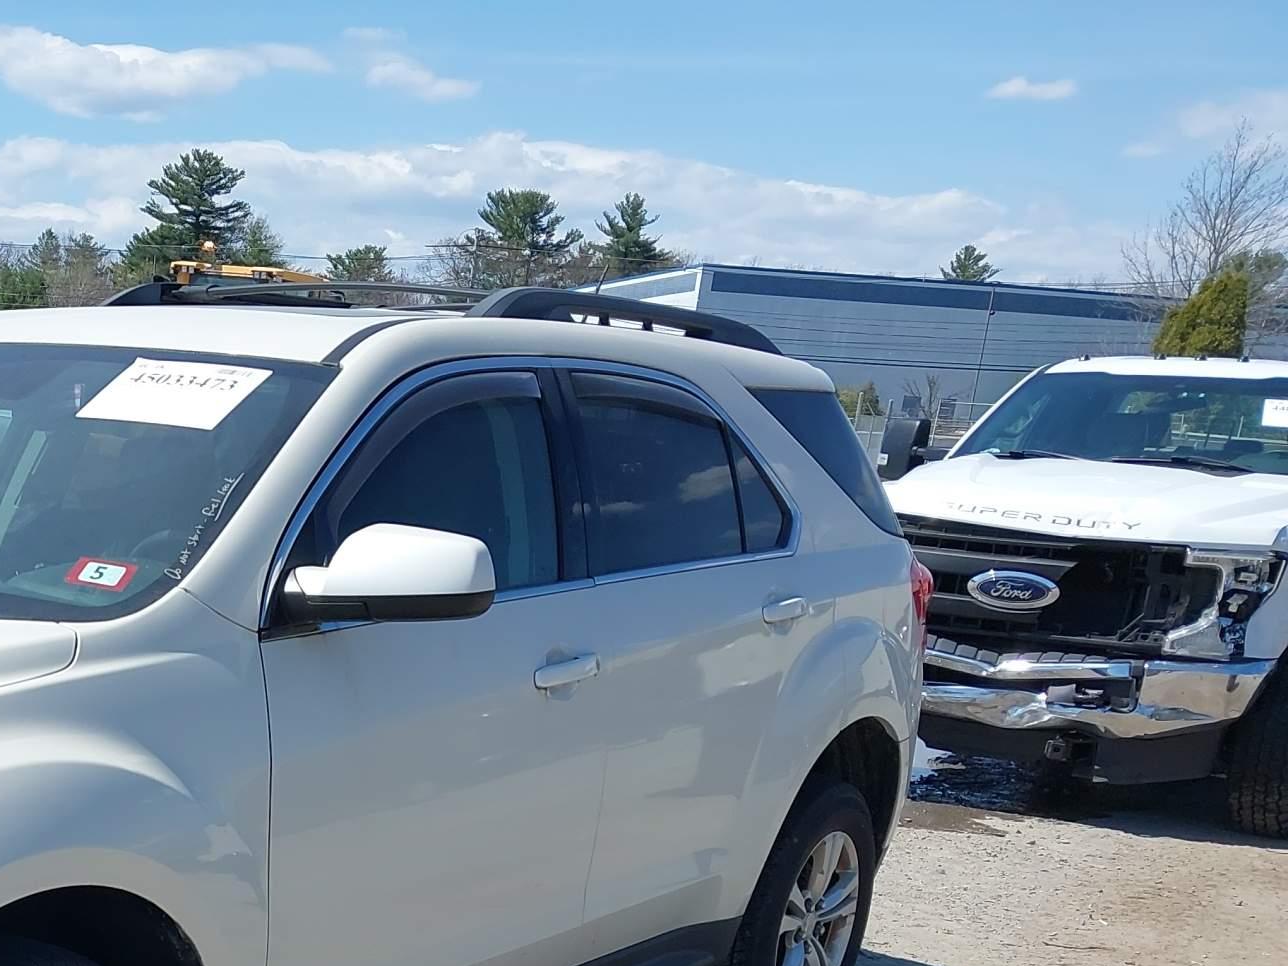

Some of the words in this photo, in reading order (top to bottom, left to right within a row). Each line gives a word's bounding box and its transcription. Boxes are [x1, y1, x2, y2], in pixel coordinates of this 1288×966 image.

[130, 372, 239, 391] 45033473
[1051, 514, 1142, 531] DUTY
[89, 565, 109, 580] 5
[990, 580, 1033, 600] Ford
